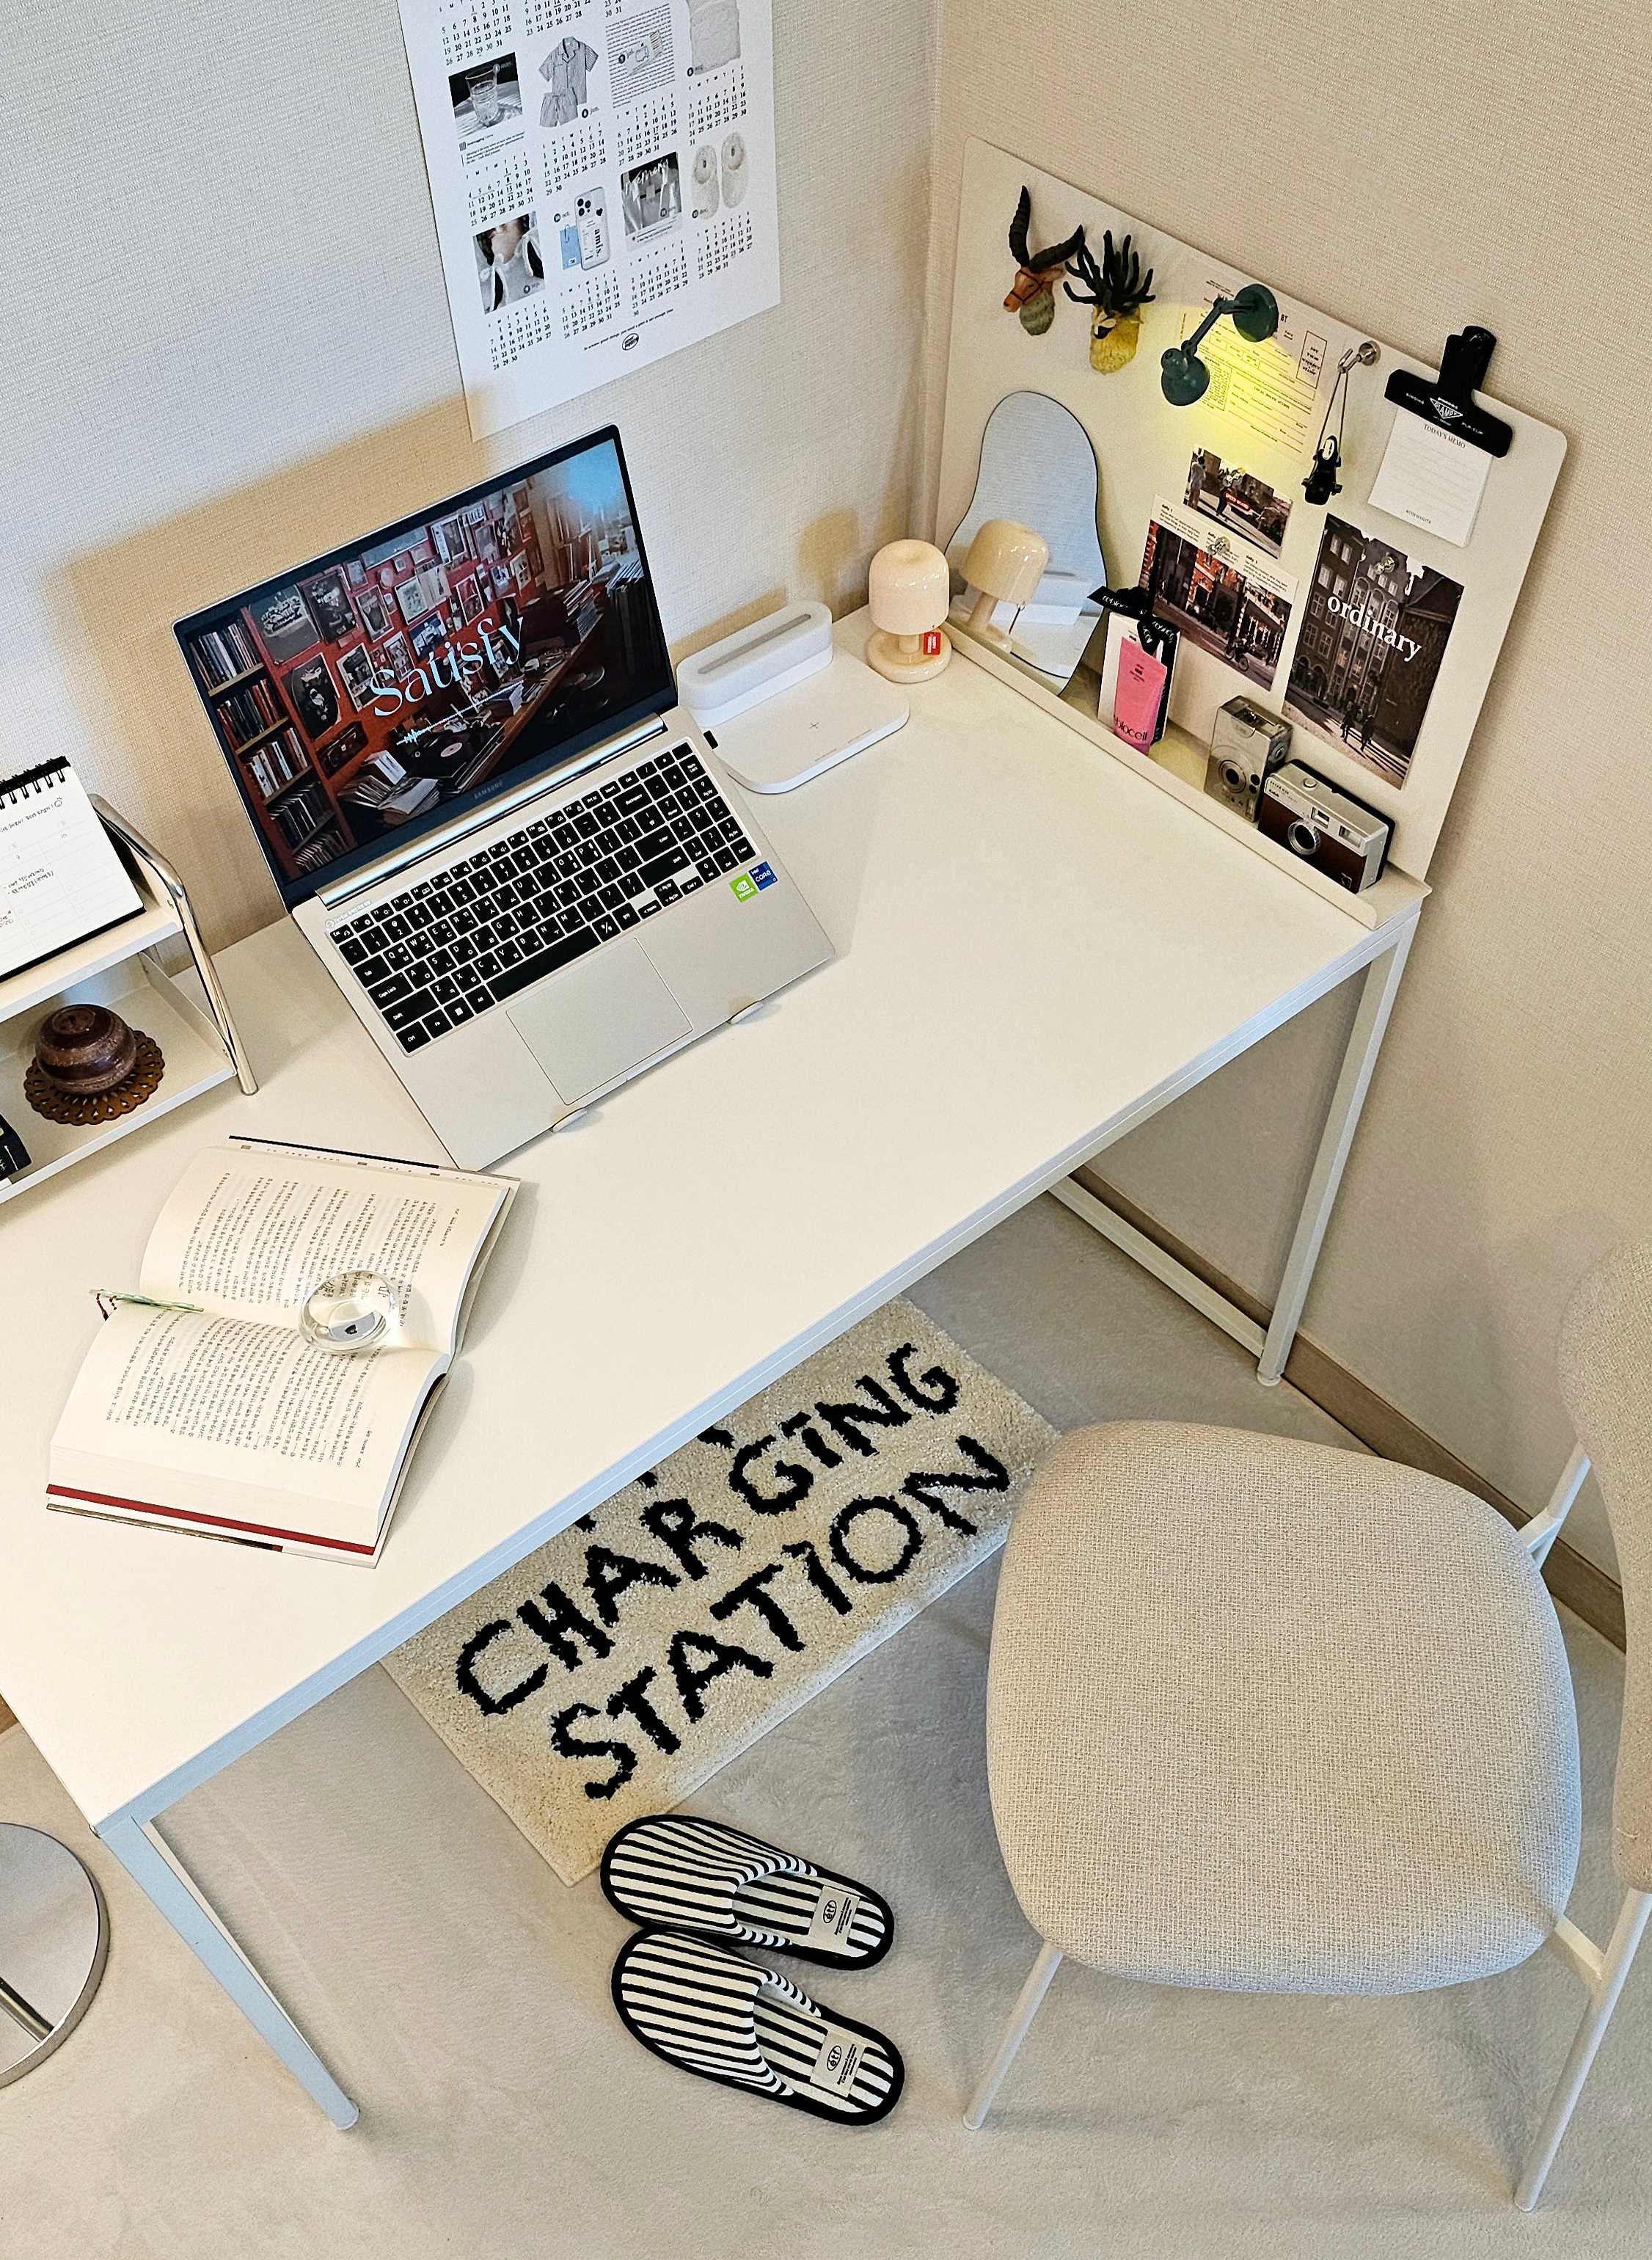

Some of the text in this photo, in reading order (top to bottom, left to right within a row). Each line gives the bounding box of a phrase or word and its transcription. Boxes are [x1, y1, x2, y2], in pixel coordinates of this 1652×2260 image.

[442, 14, 511, 45] 12 13 14 15 16 17 18
[444, 25, 512, 55] 19 20 21 22 23 24 25
[445, 39, 503, 66] 26 27 28 29 30 31
[1448, 435, 1466, 449] MEMO
[1327, 593, 1422, 662] ordinary
[370, 616, 524, 716] Satisfy
[455, 1341, 960, 1717] CHARGING
[550, 1434, 1010, 1801] STATION
